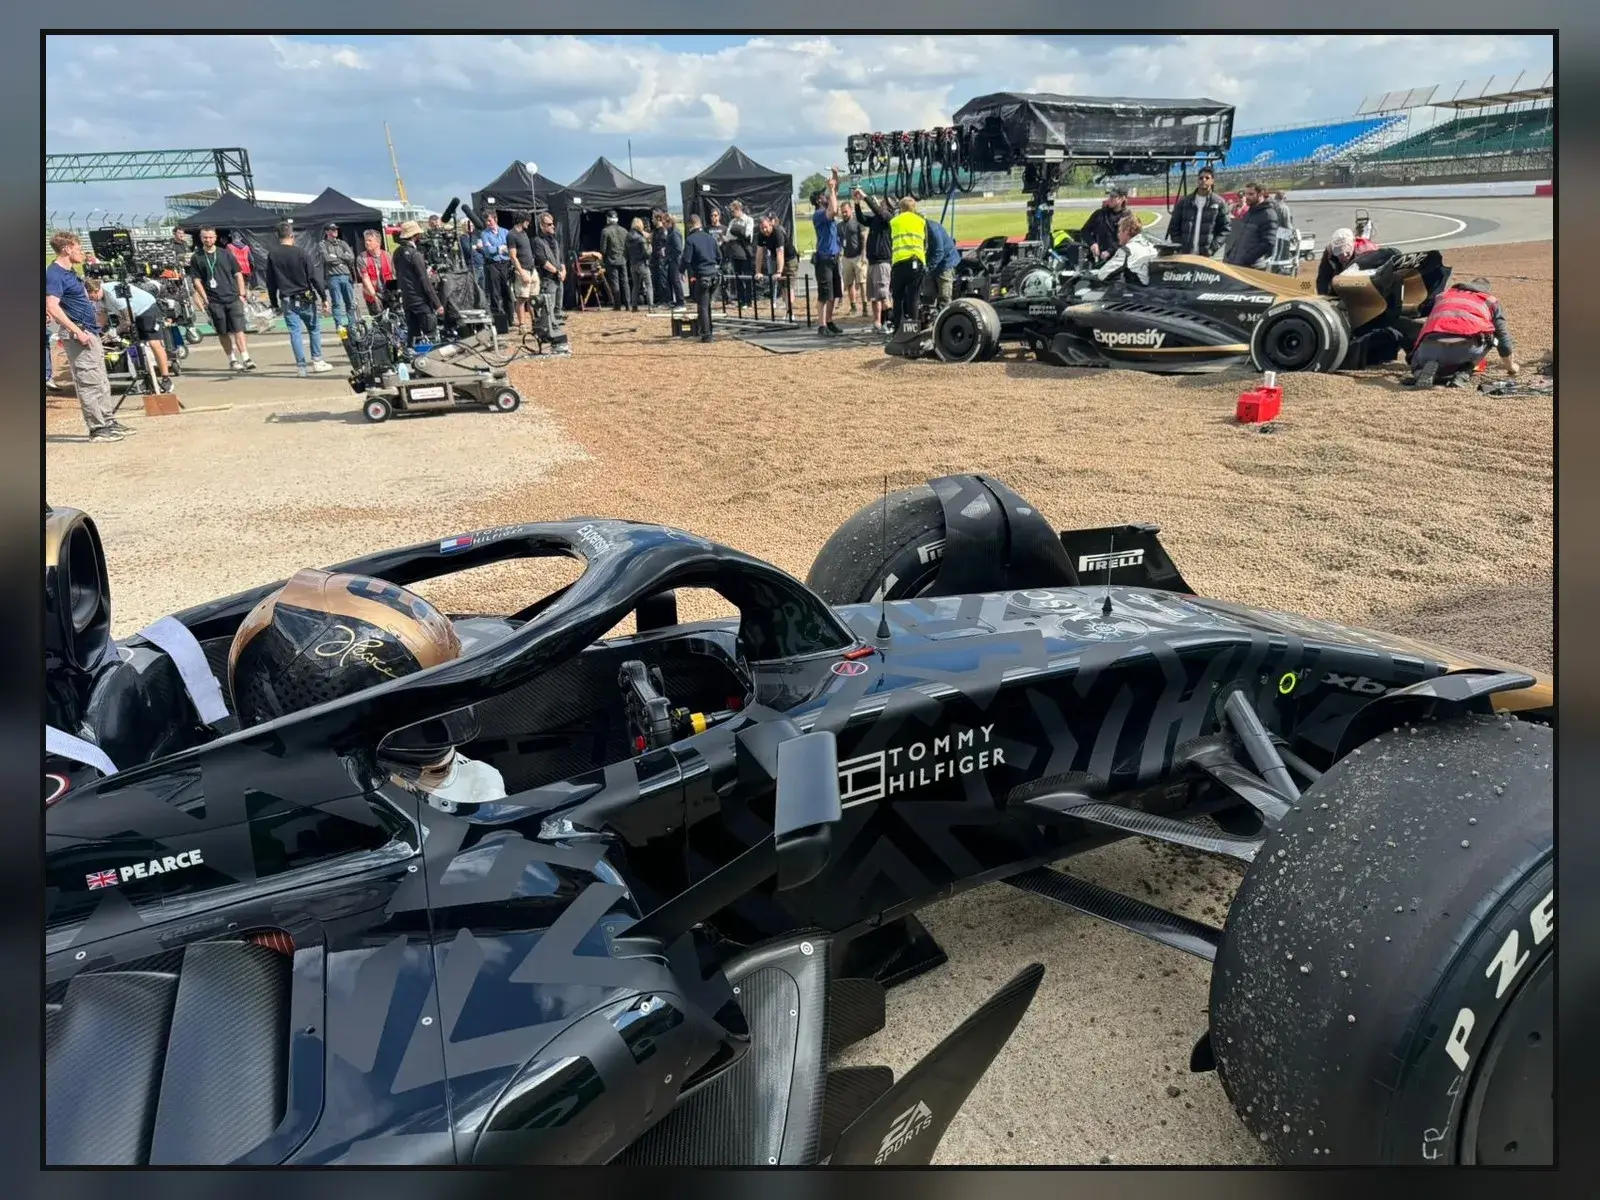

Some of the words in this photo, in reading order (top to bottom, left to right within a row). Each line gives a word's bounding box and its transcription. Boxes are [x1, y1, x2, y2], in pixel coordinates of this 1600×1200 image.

[1093, 328, 1166, 349] Expensify
[1078, 548, 1145, 572] PIRELLI
[888, 723, 995, 767] TOMMY
[888, 747, 1006, 795] HILFIGER
[119, 849, 204, 882] PEARCE
[874, 1114, 933, 1166] SPORTS
